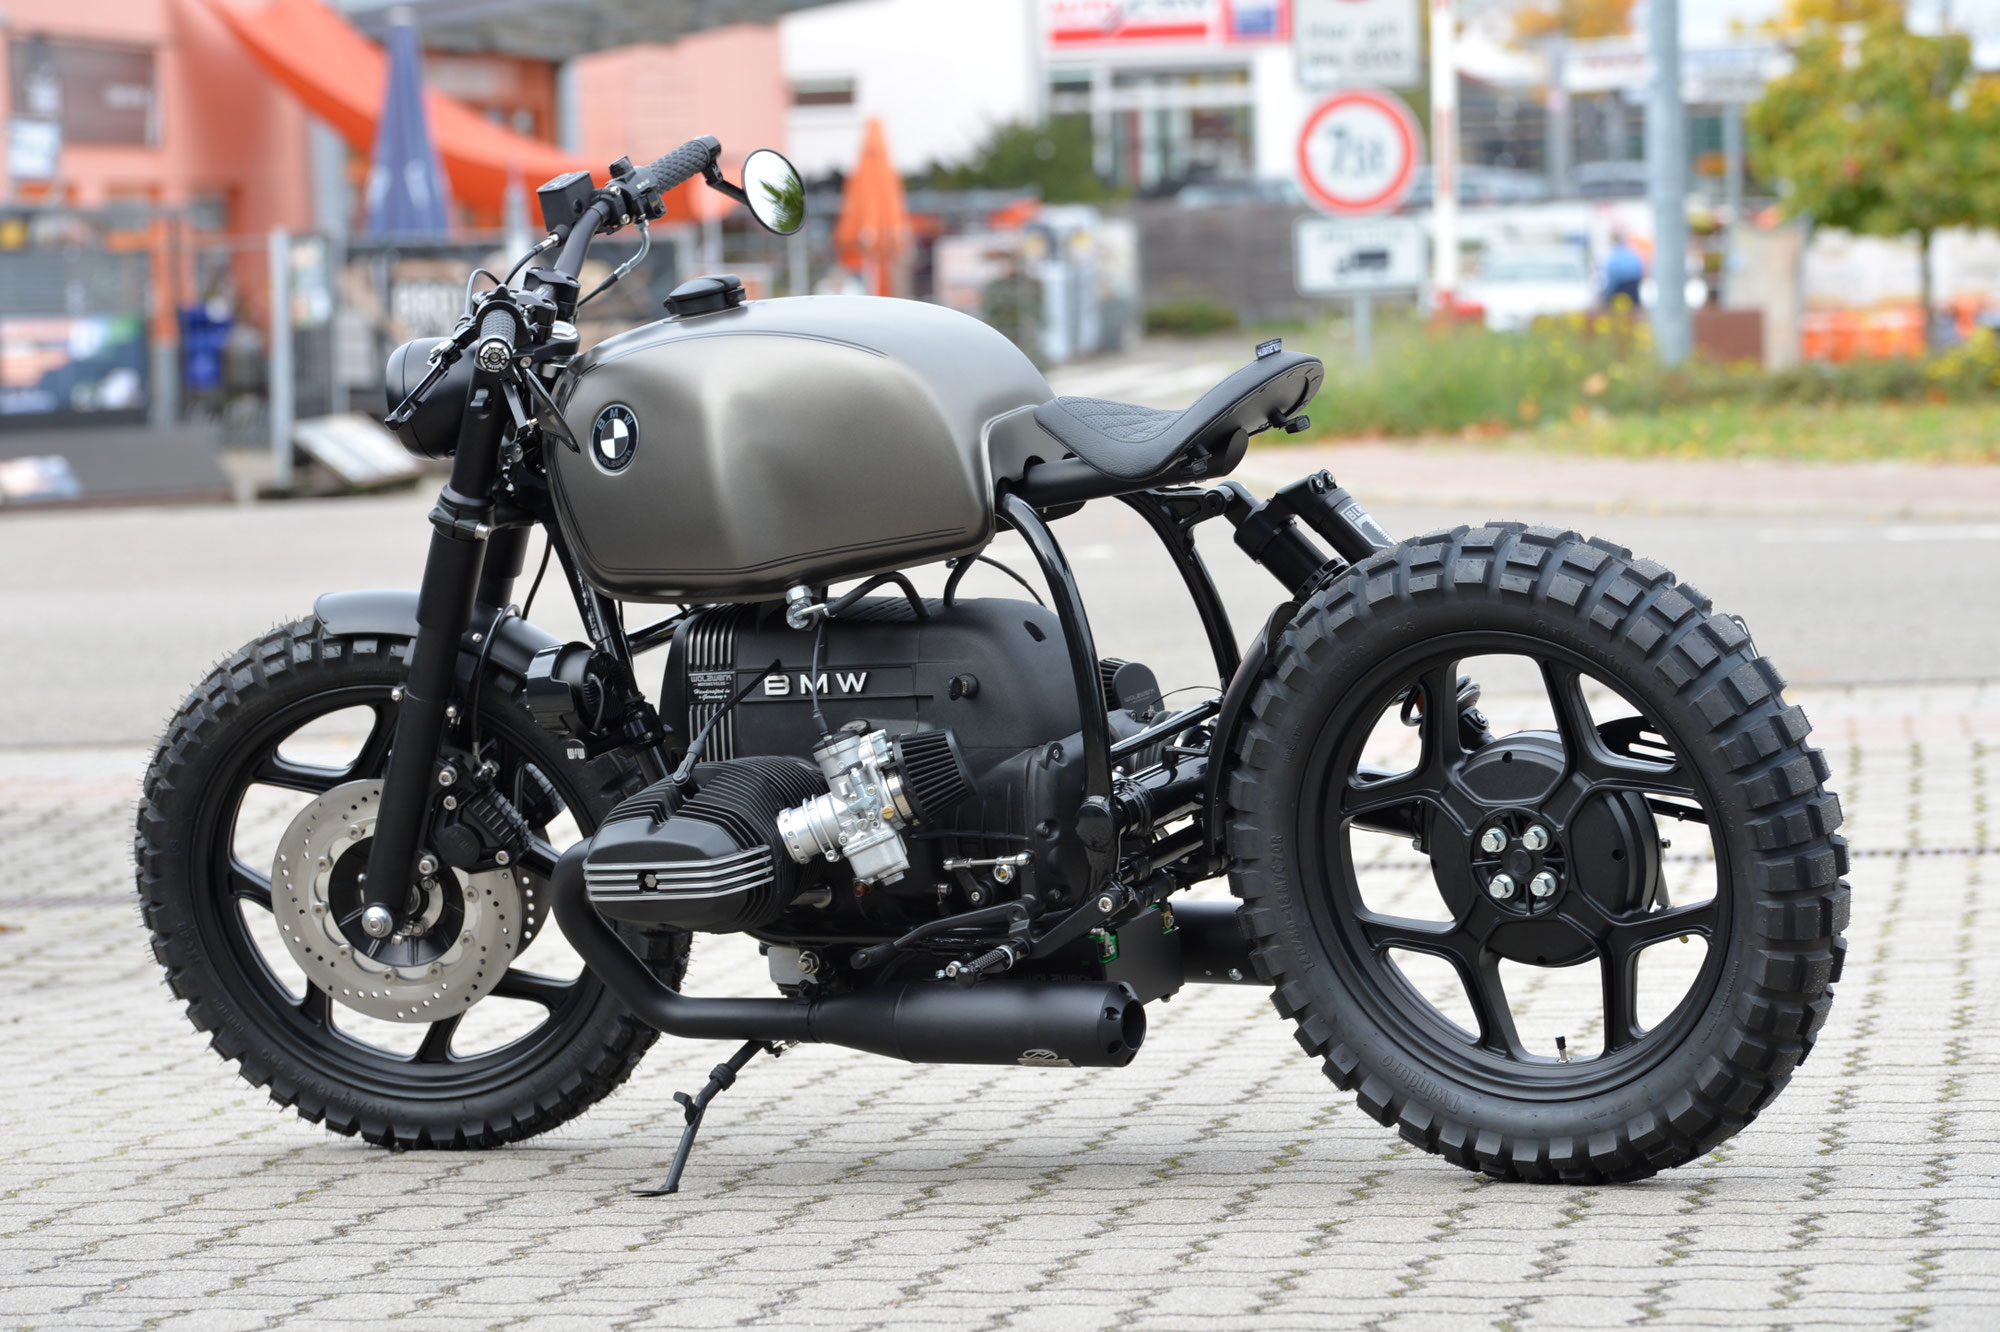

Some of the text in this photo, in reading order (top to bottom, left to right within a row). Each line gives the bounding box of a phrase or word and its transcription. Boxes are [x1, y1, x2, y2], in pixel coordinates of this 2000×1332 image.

[596, 408, 634, 431] BMW
[764, 672, 868, 696] BMW
[702, 693, 724, 701] Germany
[1382, 1055, 1461, 1115] Twinduro
